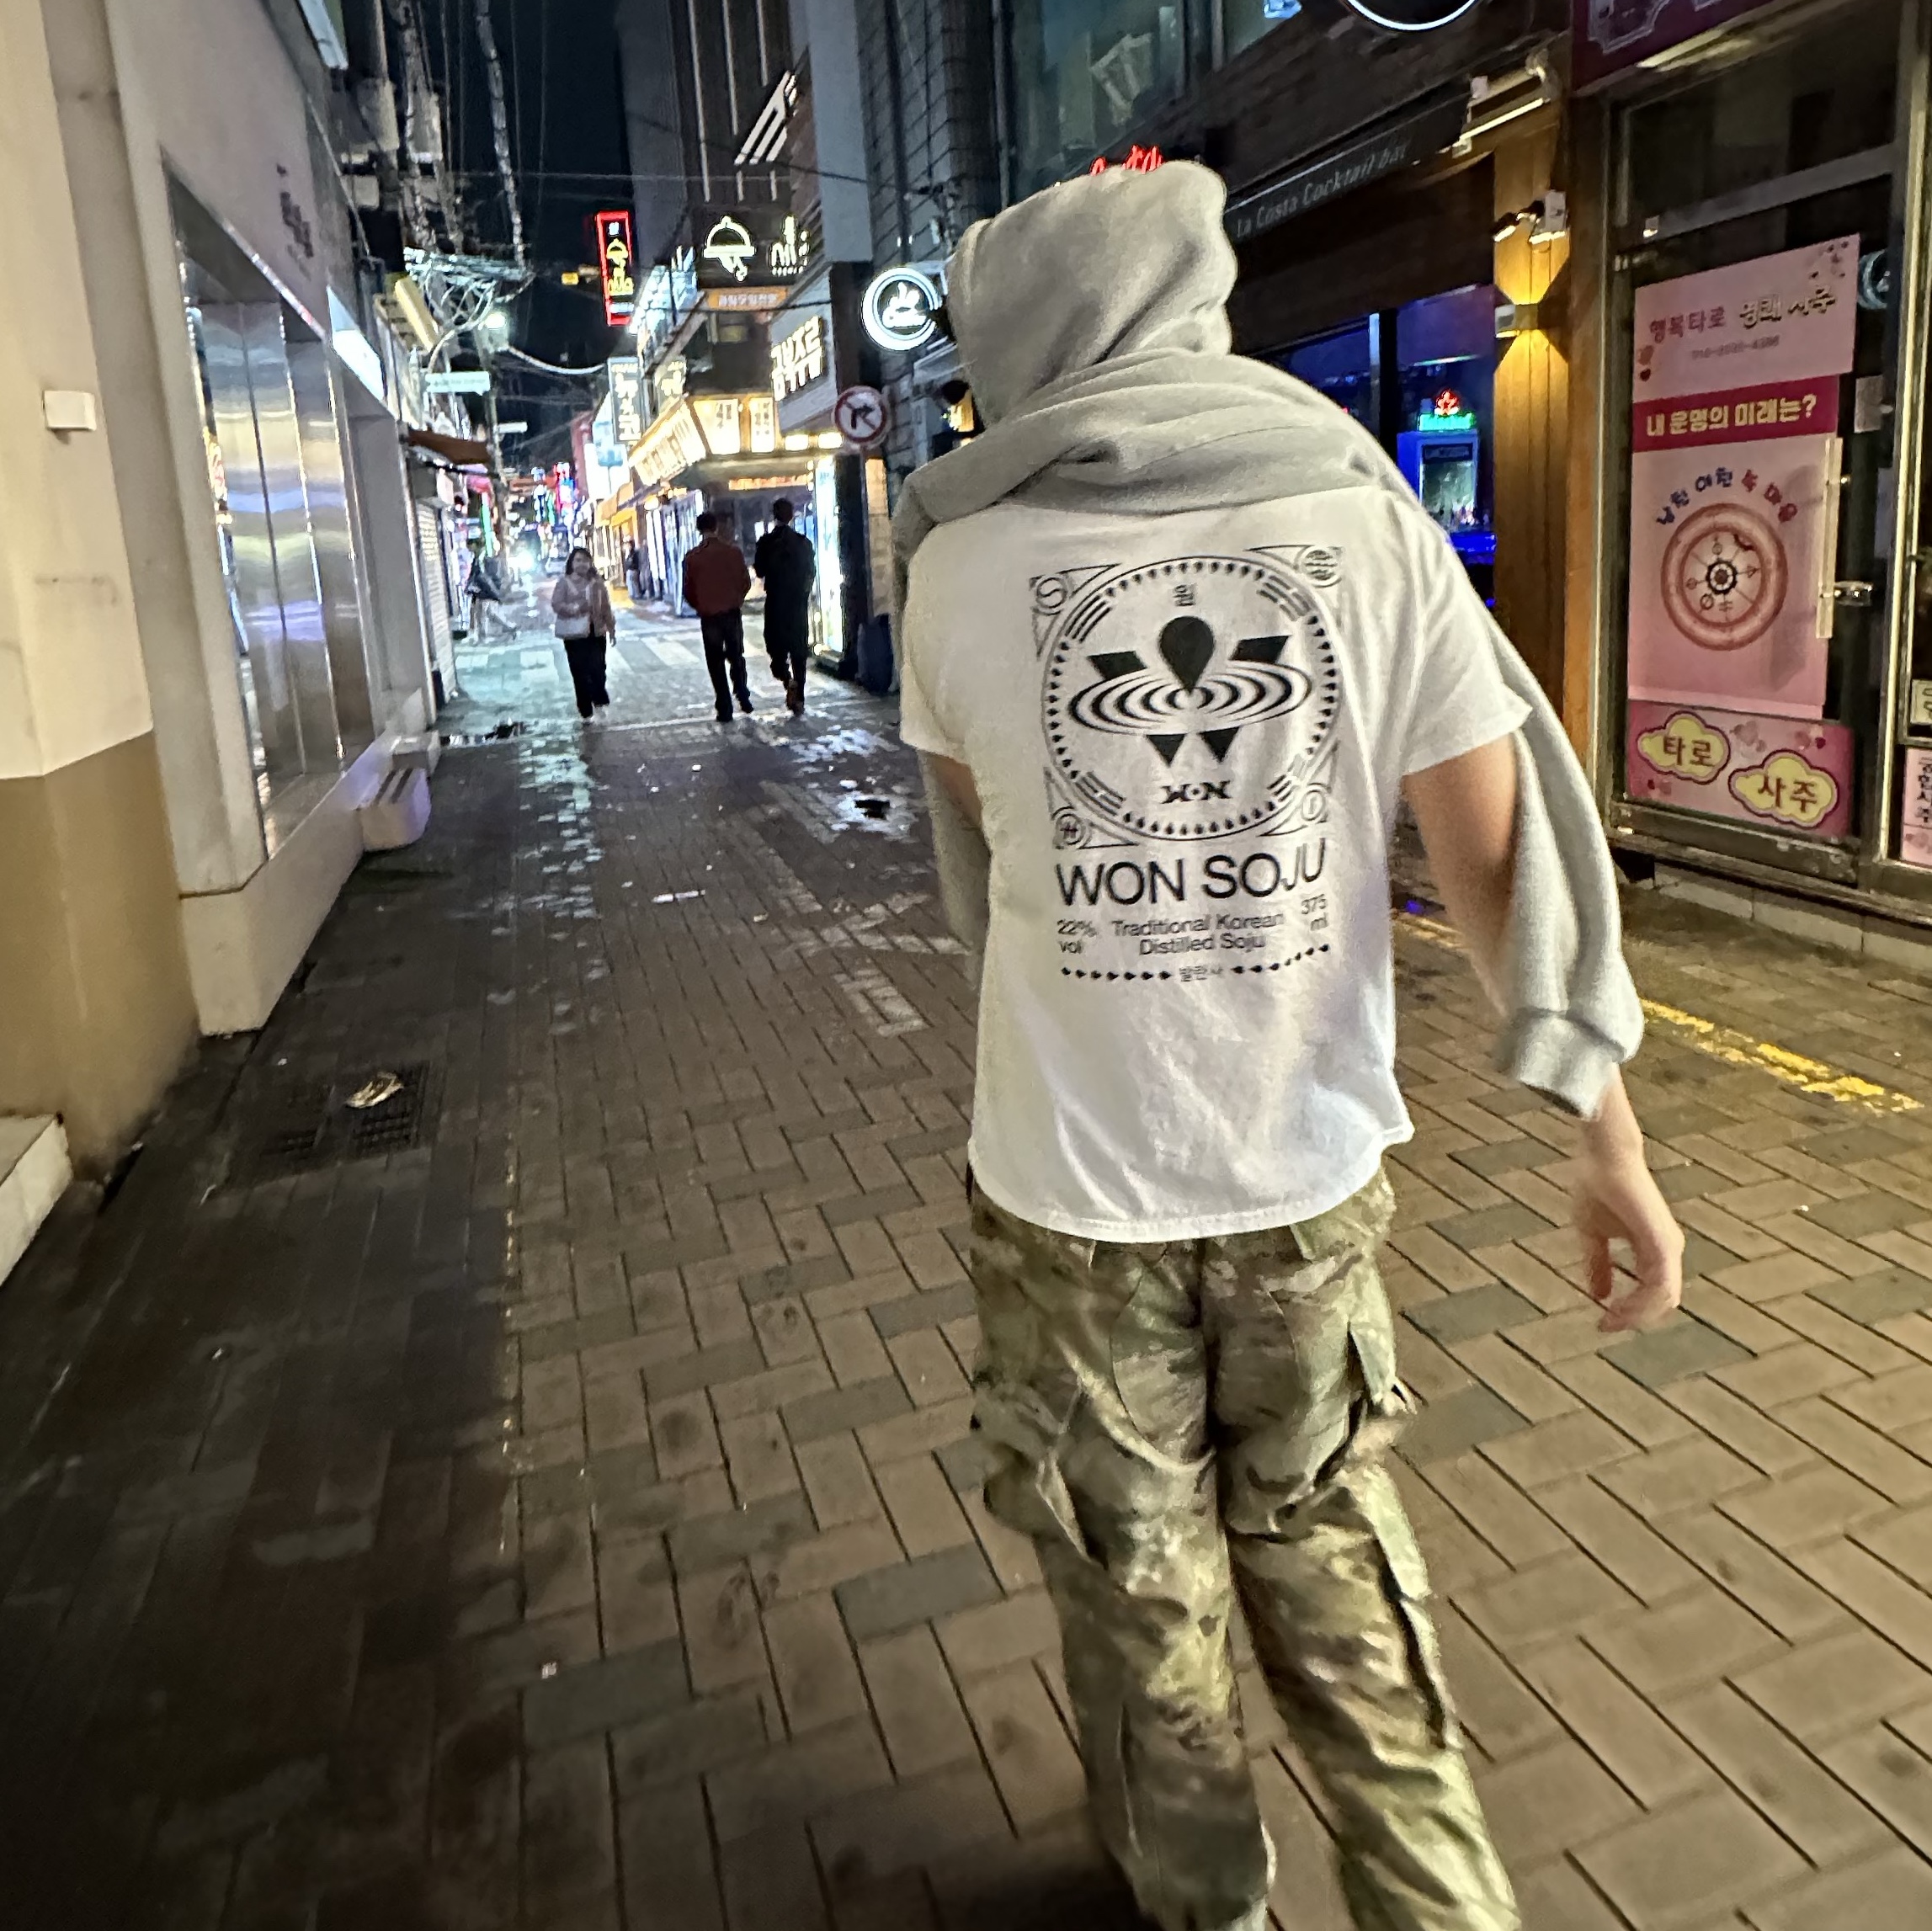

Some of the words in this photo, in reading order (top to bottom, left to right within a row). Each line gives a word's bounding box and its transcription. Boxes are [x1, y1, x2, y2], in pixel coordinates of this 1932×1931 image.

[1302, 152, 1376, 206] Cocktail
[1649, 306, 1726, 343] 행복타로
[1787, 285, 1836, 315] 사주
[1647, 413, 1665, 436] 내
[1669, 405, 1729, 435] 운명의
[1734, 393, 1817, 427] 미래는?
[1656, 491, 1690, 524] 남친
[1695, 467, 1733, 492] 여친
[1663, 736, 1716, 767] 타로
[1758, 774, 1817, 813] 사주
[1055, 859, 1185, 906] WON
[1202, 838, 1326, 899] SOJU
[1301, 893, 1328, 915] 375
[1056, 918, 1099, 938] 22%
[1111, 913, 1215, 936] Traditional
[1216, 912, 1285, 929] Korean
[1310, 916, 1328, 931] ml
[1059, 939, 1084, 955] vol
[1139, 934, 1216, 955] Distilled
[1220, 932, 1267, 952] Soju
